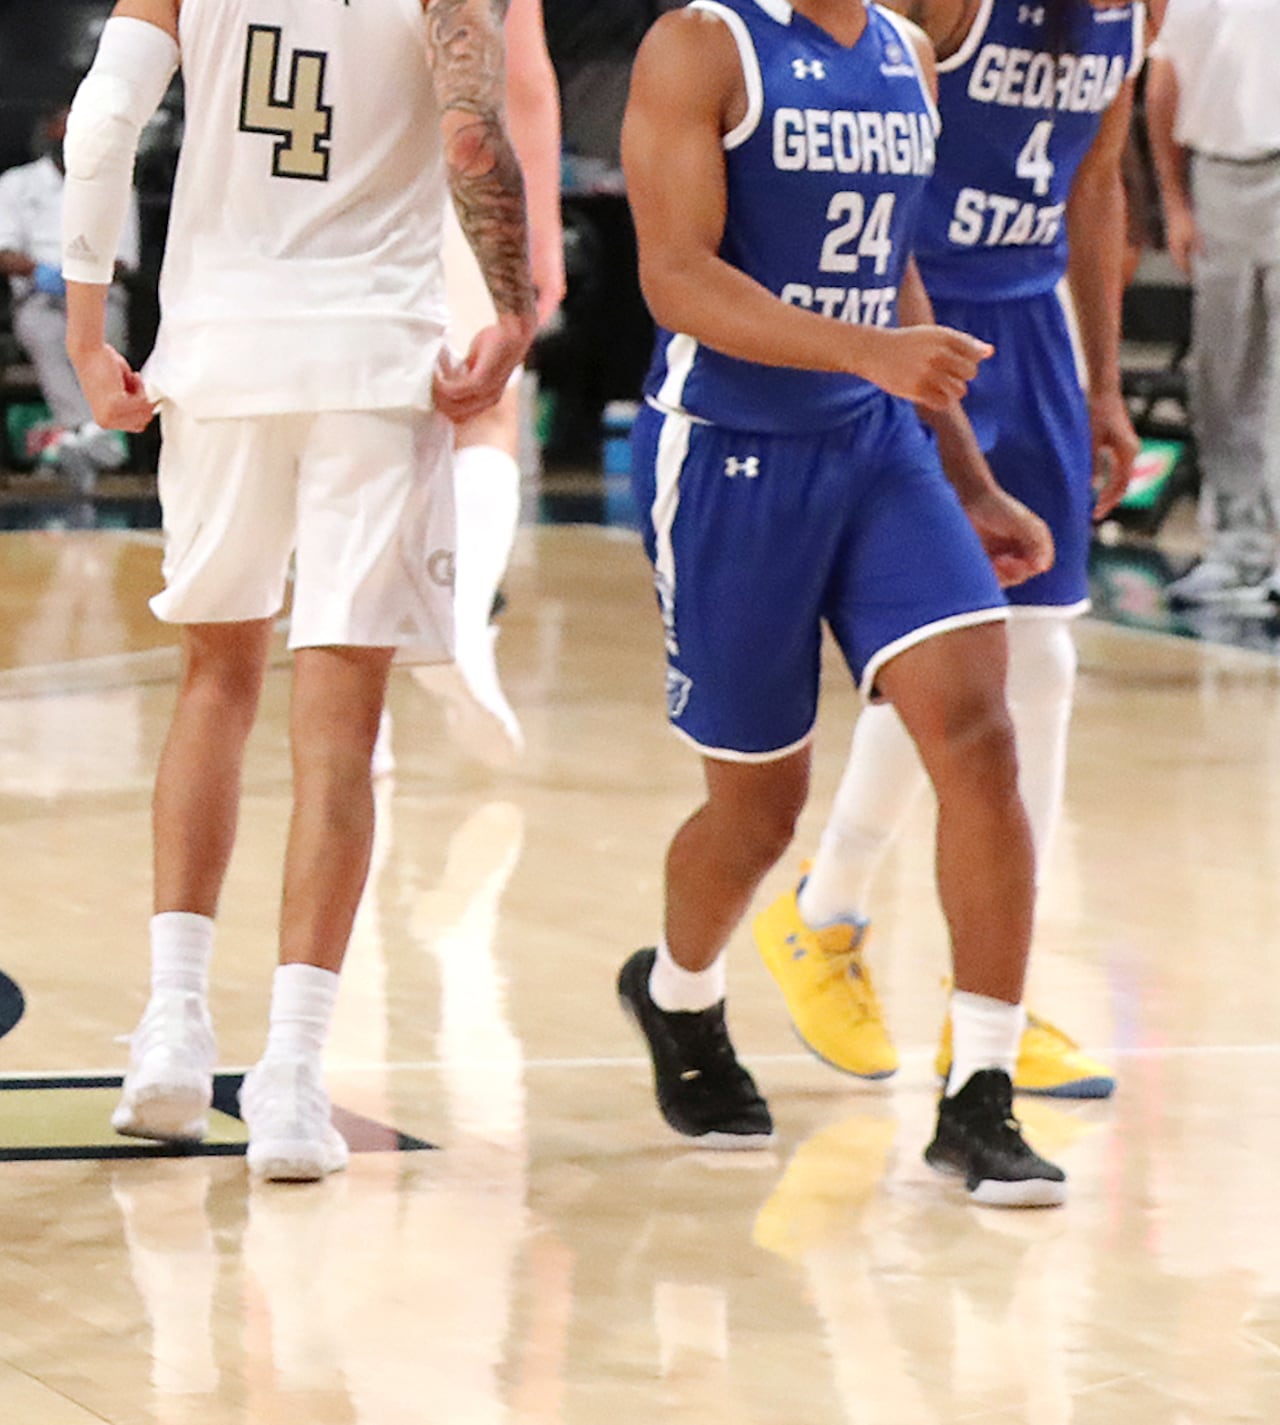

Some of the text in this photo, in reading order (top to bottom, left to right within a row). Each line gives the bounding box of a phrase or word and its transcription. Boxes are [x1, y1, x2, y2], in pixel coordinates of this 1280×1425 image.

[238, 23, 334, 182] 4
[967, 43, 1126, 114] GEORGIA
[772, 107, 937, 177] GEORGIA
[1015, 119, 1055, 197] 4
[818, 191, 896, 276] 24
